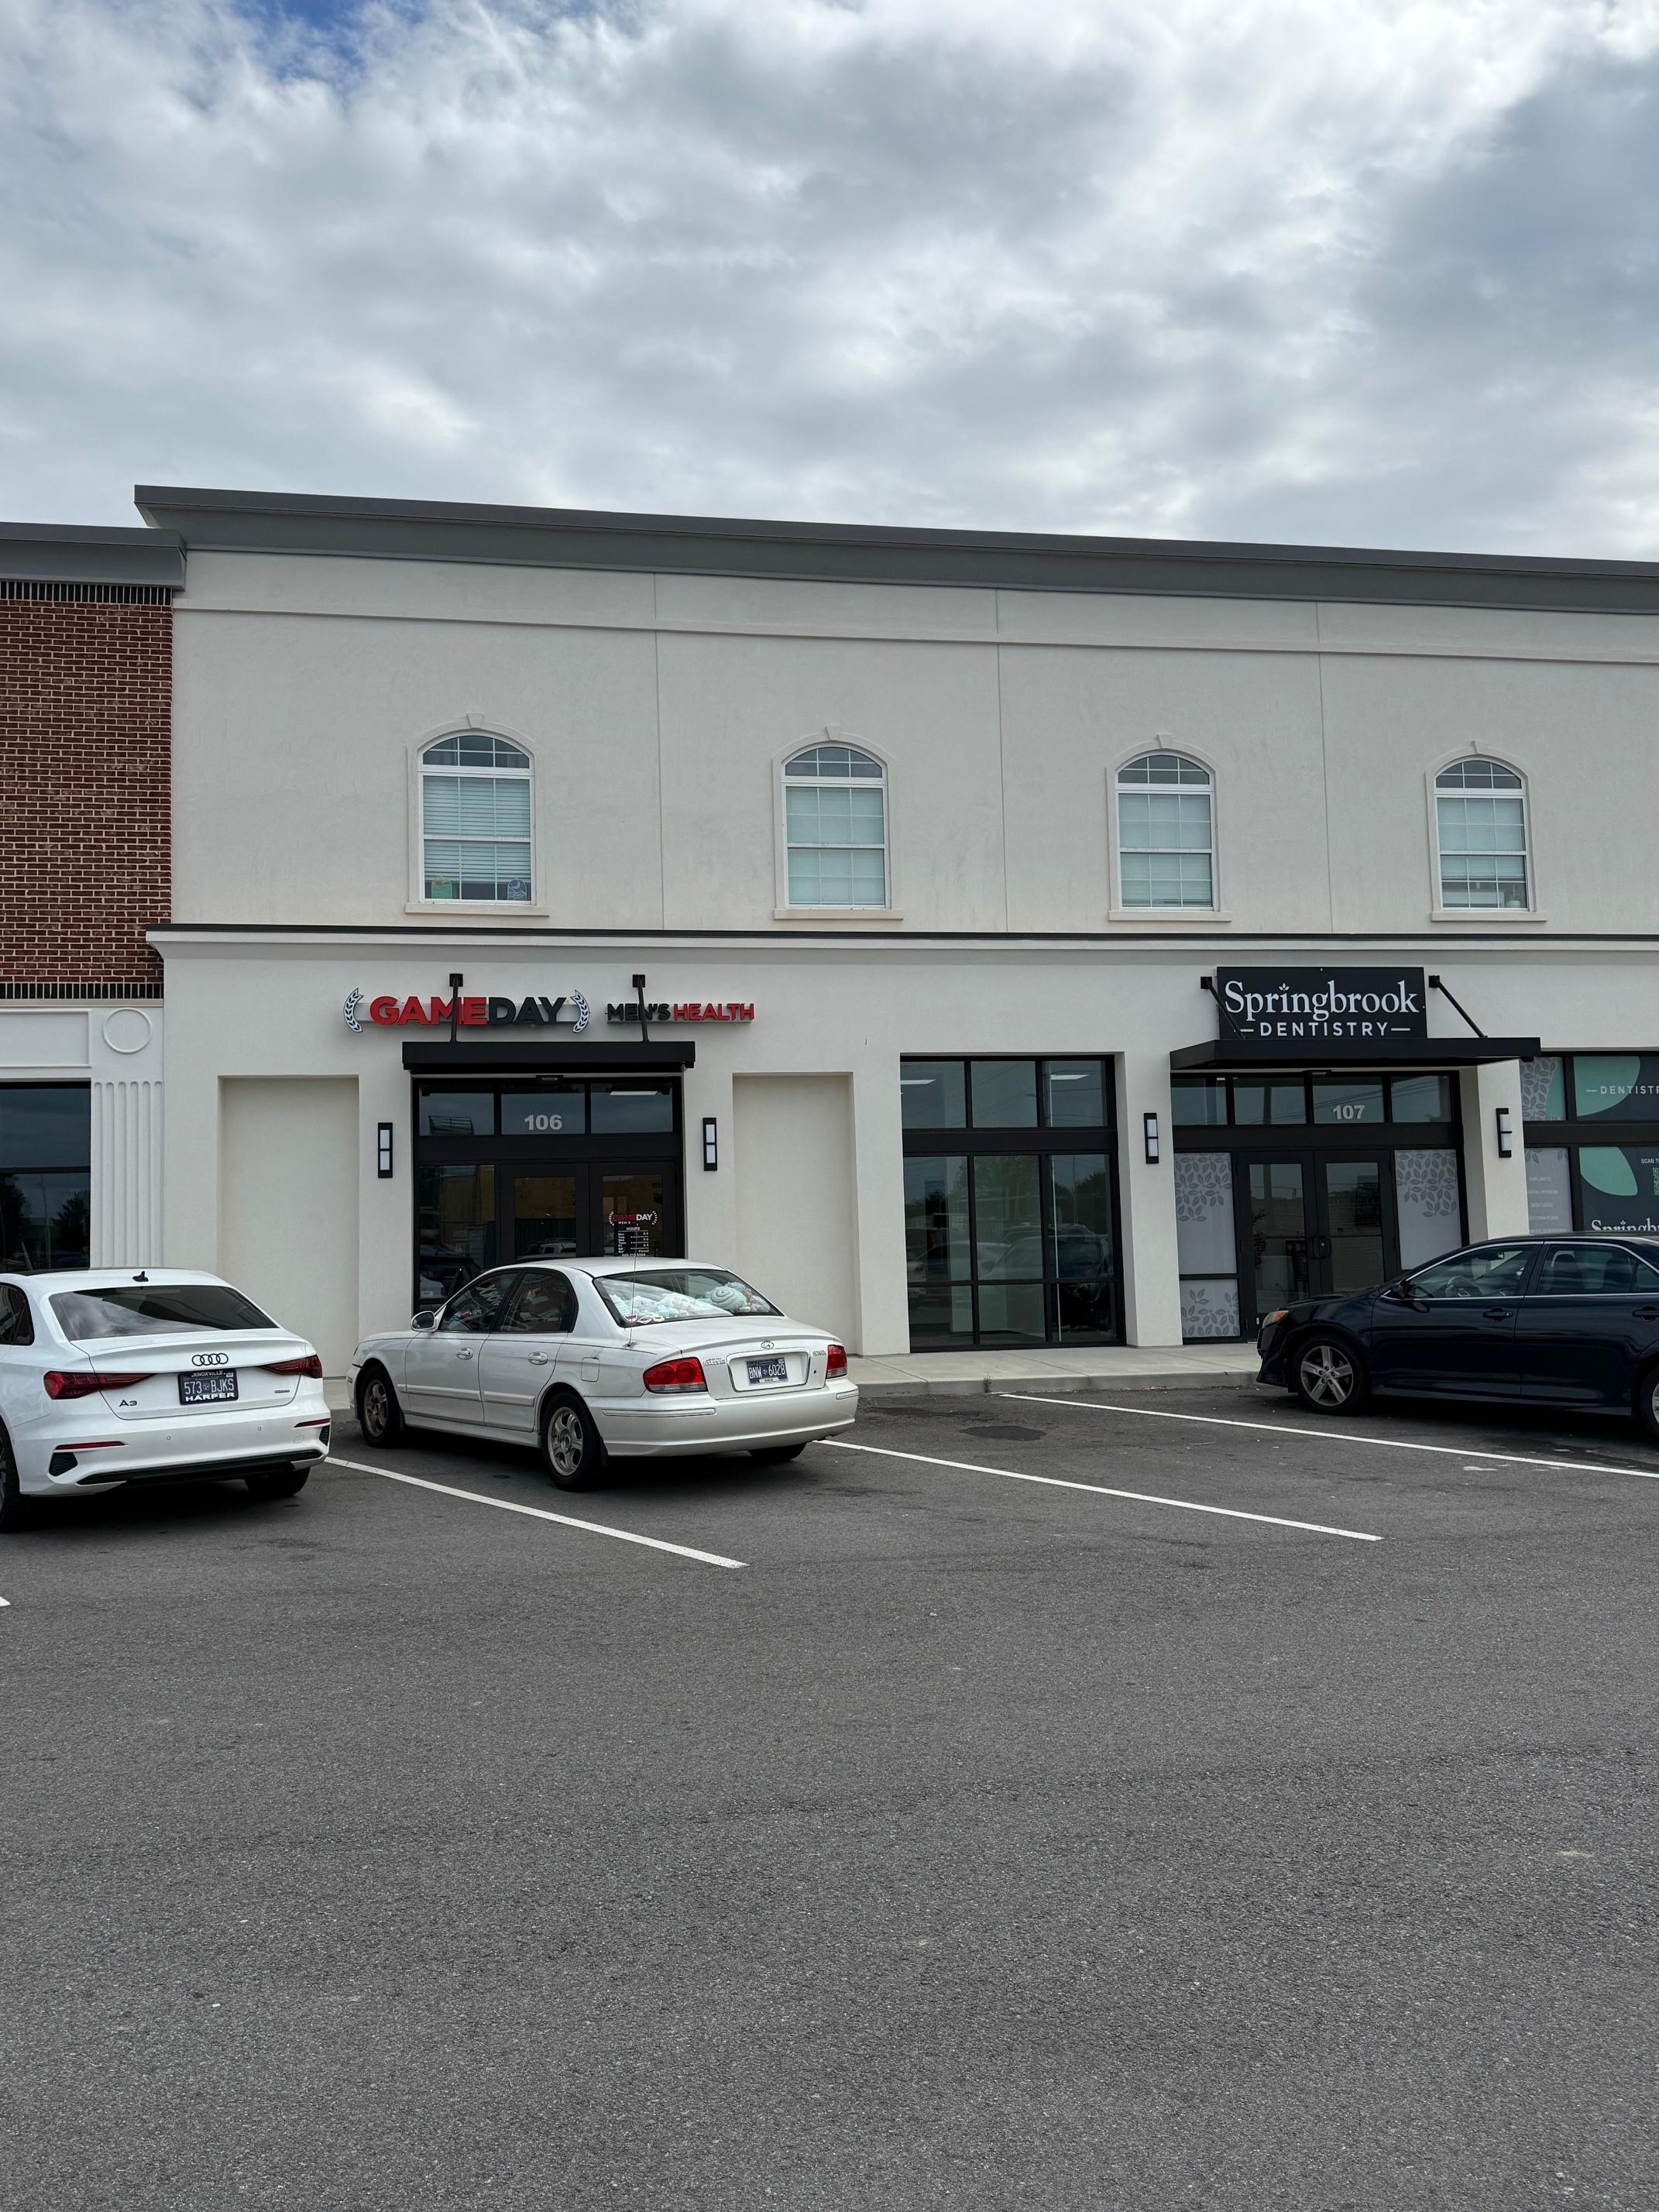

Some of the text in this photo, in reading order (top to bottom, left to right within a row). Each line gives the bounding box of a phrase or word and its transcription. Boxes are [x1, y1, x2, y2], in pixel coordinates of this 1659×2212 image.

[1224, 980, 1419, 1022] Springbrook
[369, 996, 754, 1025] GAMEDAY MEN'S HEALTH
[1260, 1022, 1388, 1036] DENTISTRY
[1332, 1104, 1365, 1120] 107
[524, 1115, 562, 1131] 106
[768, 1364, 786, 1376] 6028
[184, 1382, 202, 1395] 573
[118, 1399, 138, 1407] A3
[185, 1392, 235, 1402] HARPER
